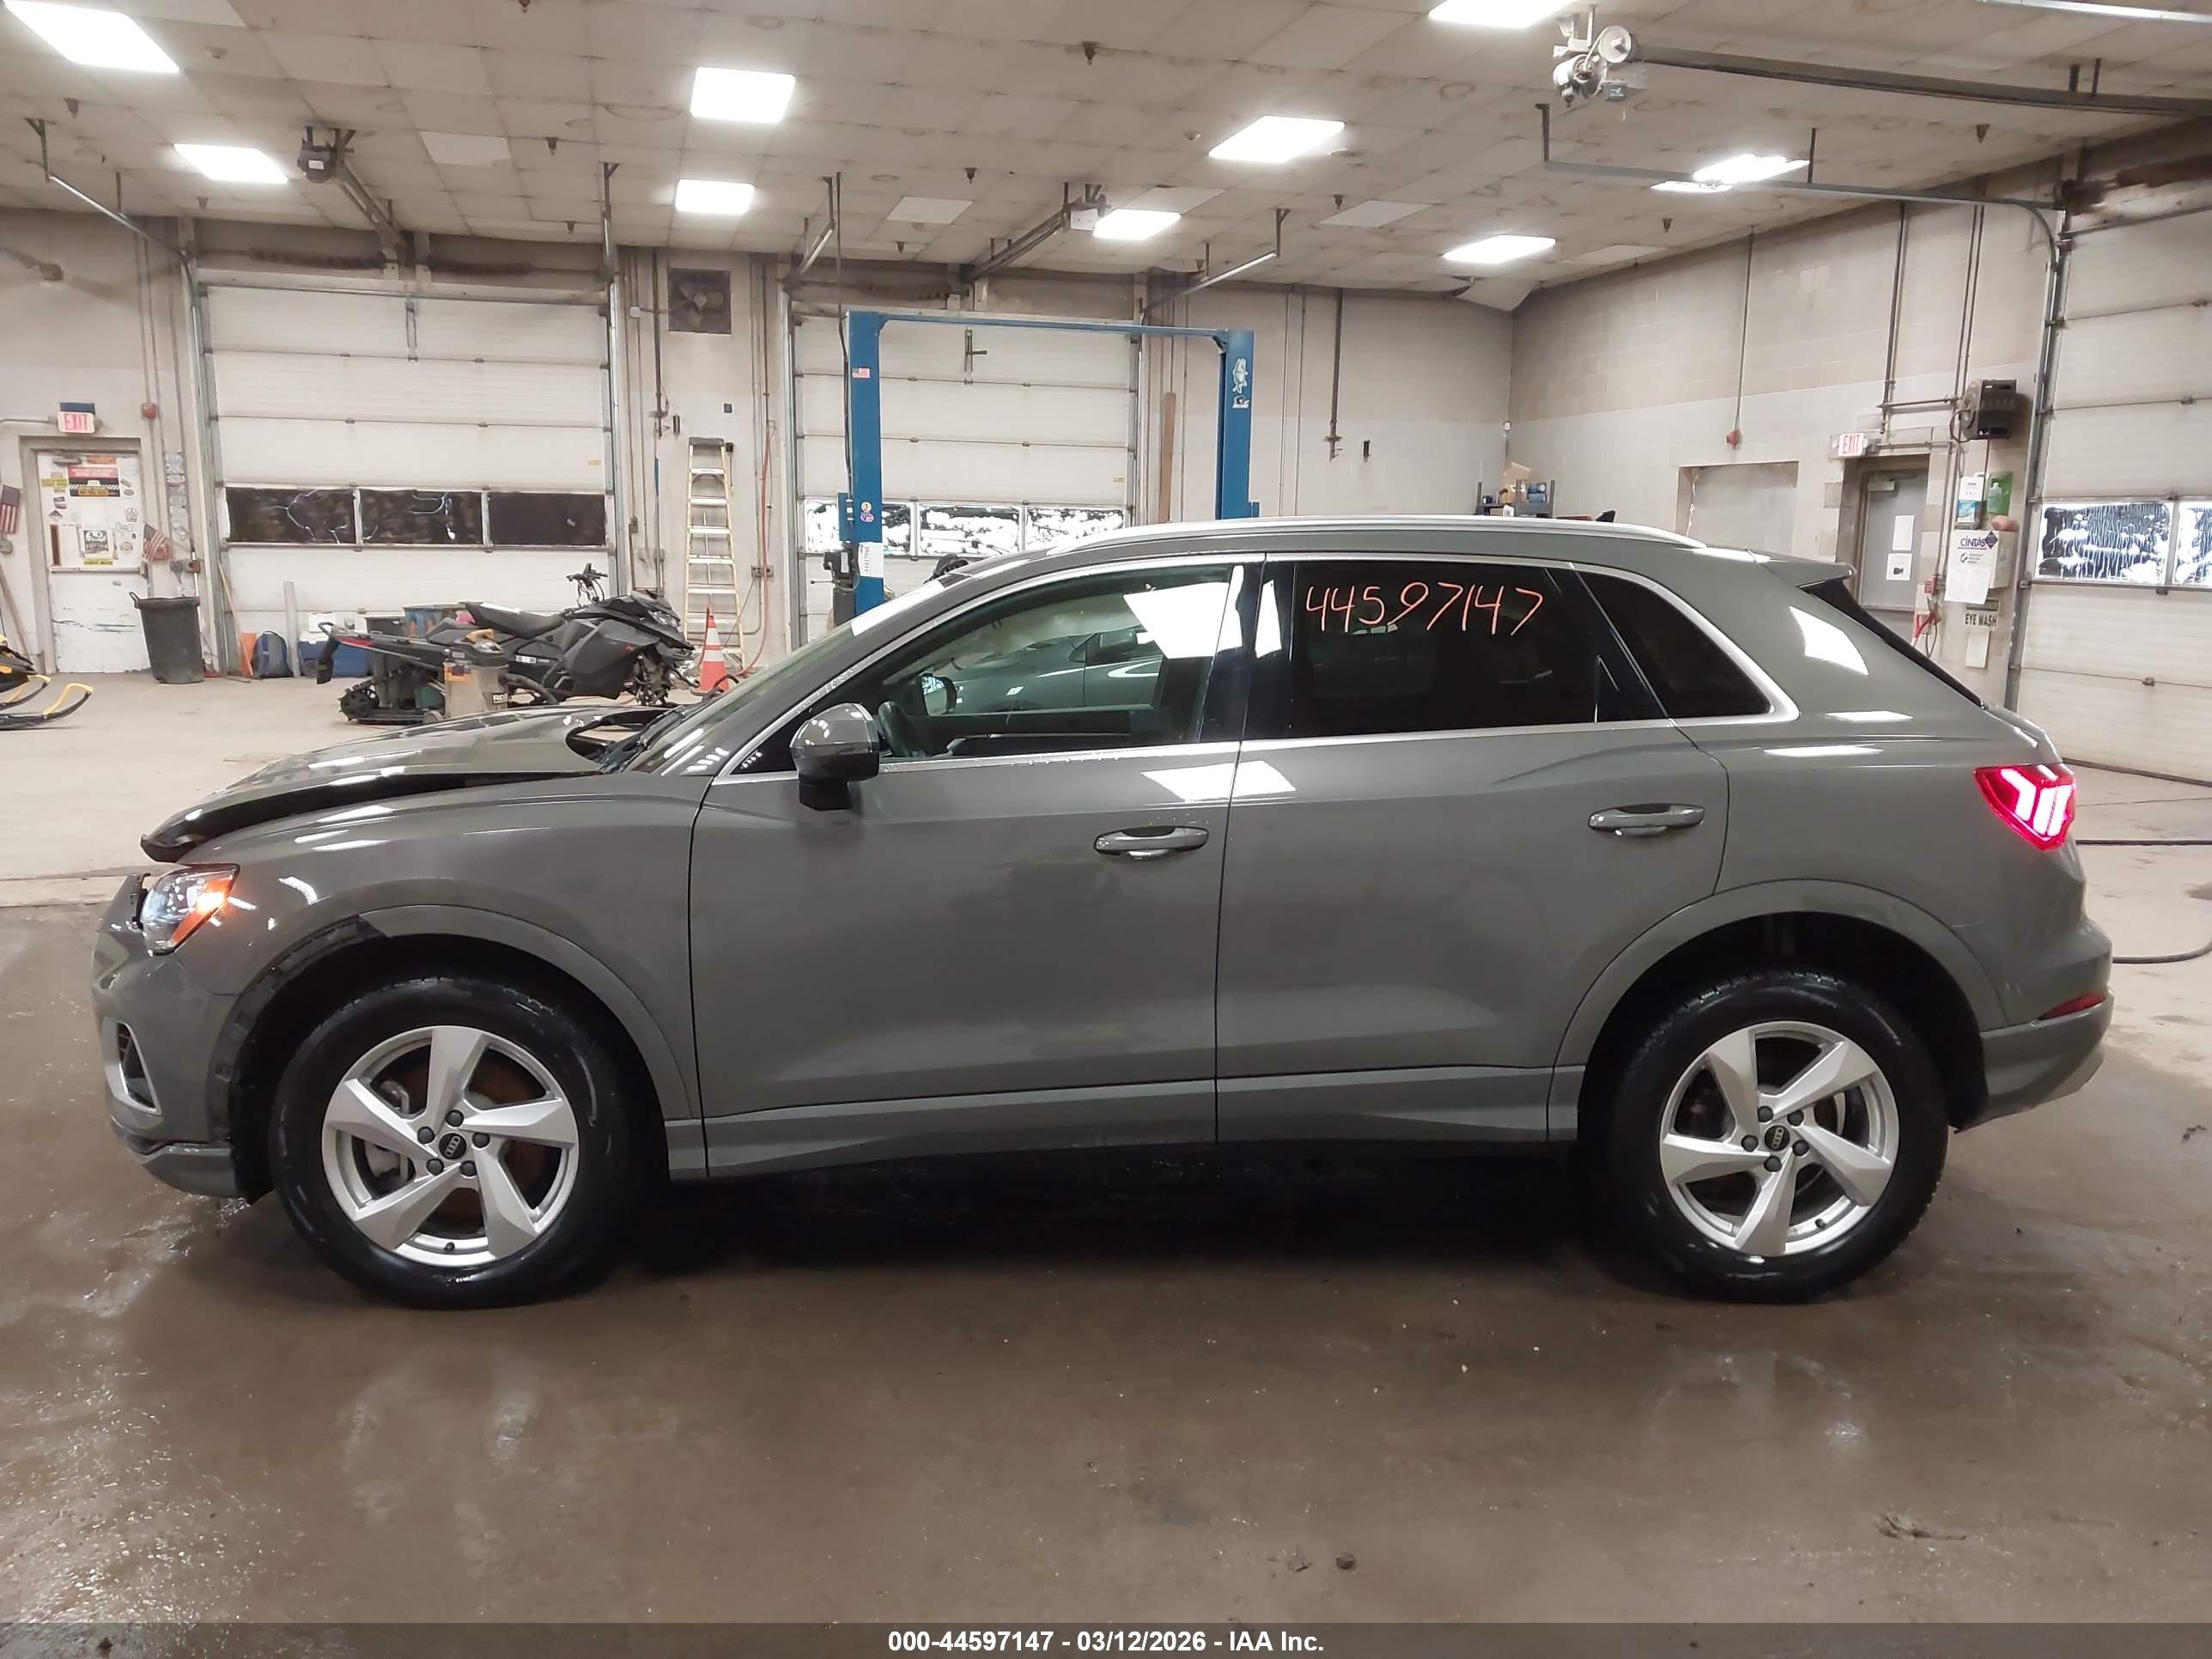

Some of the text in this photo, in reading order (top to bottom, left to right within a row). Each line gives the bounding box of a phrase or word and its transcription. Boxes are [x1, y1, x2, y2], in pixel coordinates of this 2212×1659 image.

[1843, 434, 1860, 454] EXIT
[1960, 536, 1986, 547] CINTAS
[1305, 581, 1544, 636] 44597147
[1965, 613, 1997, 627] EYE WASH
